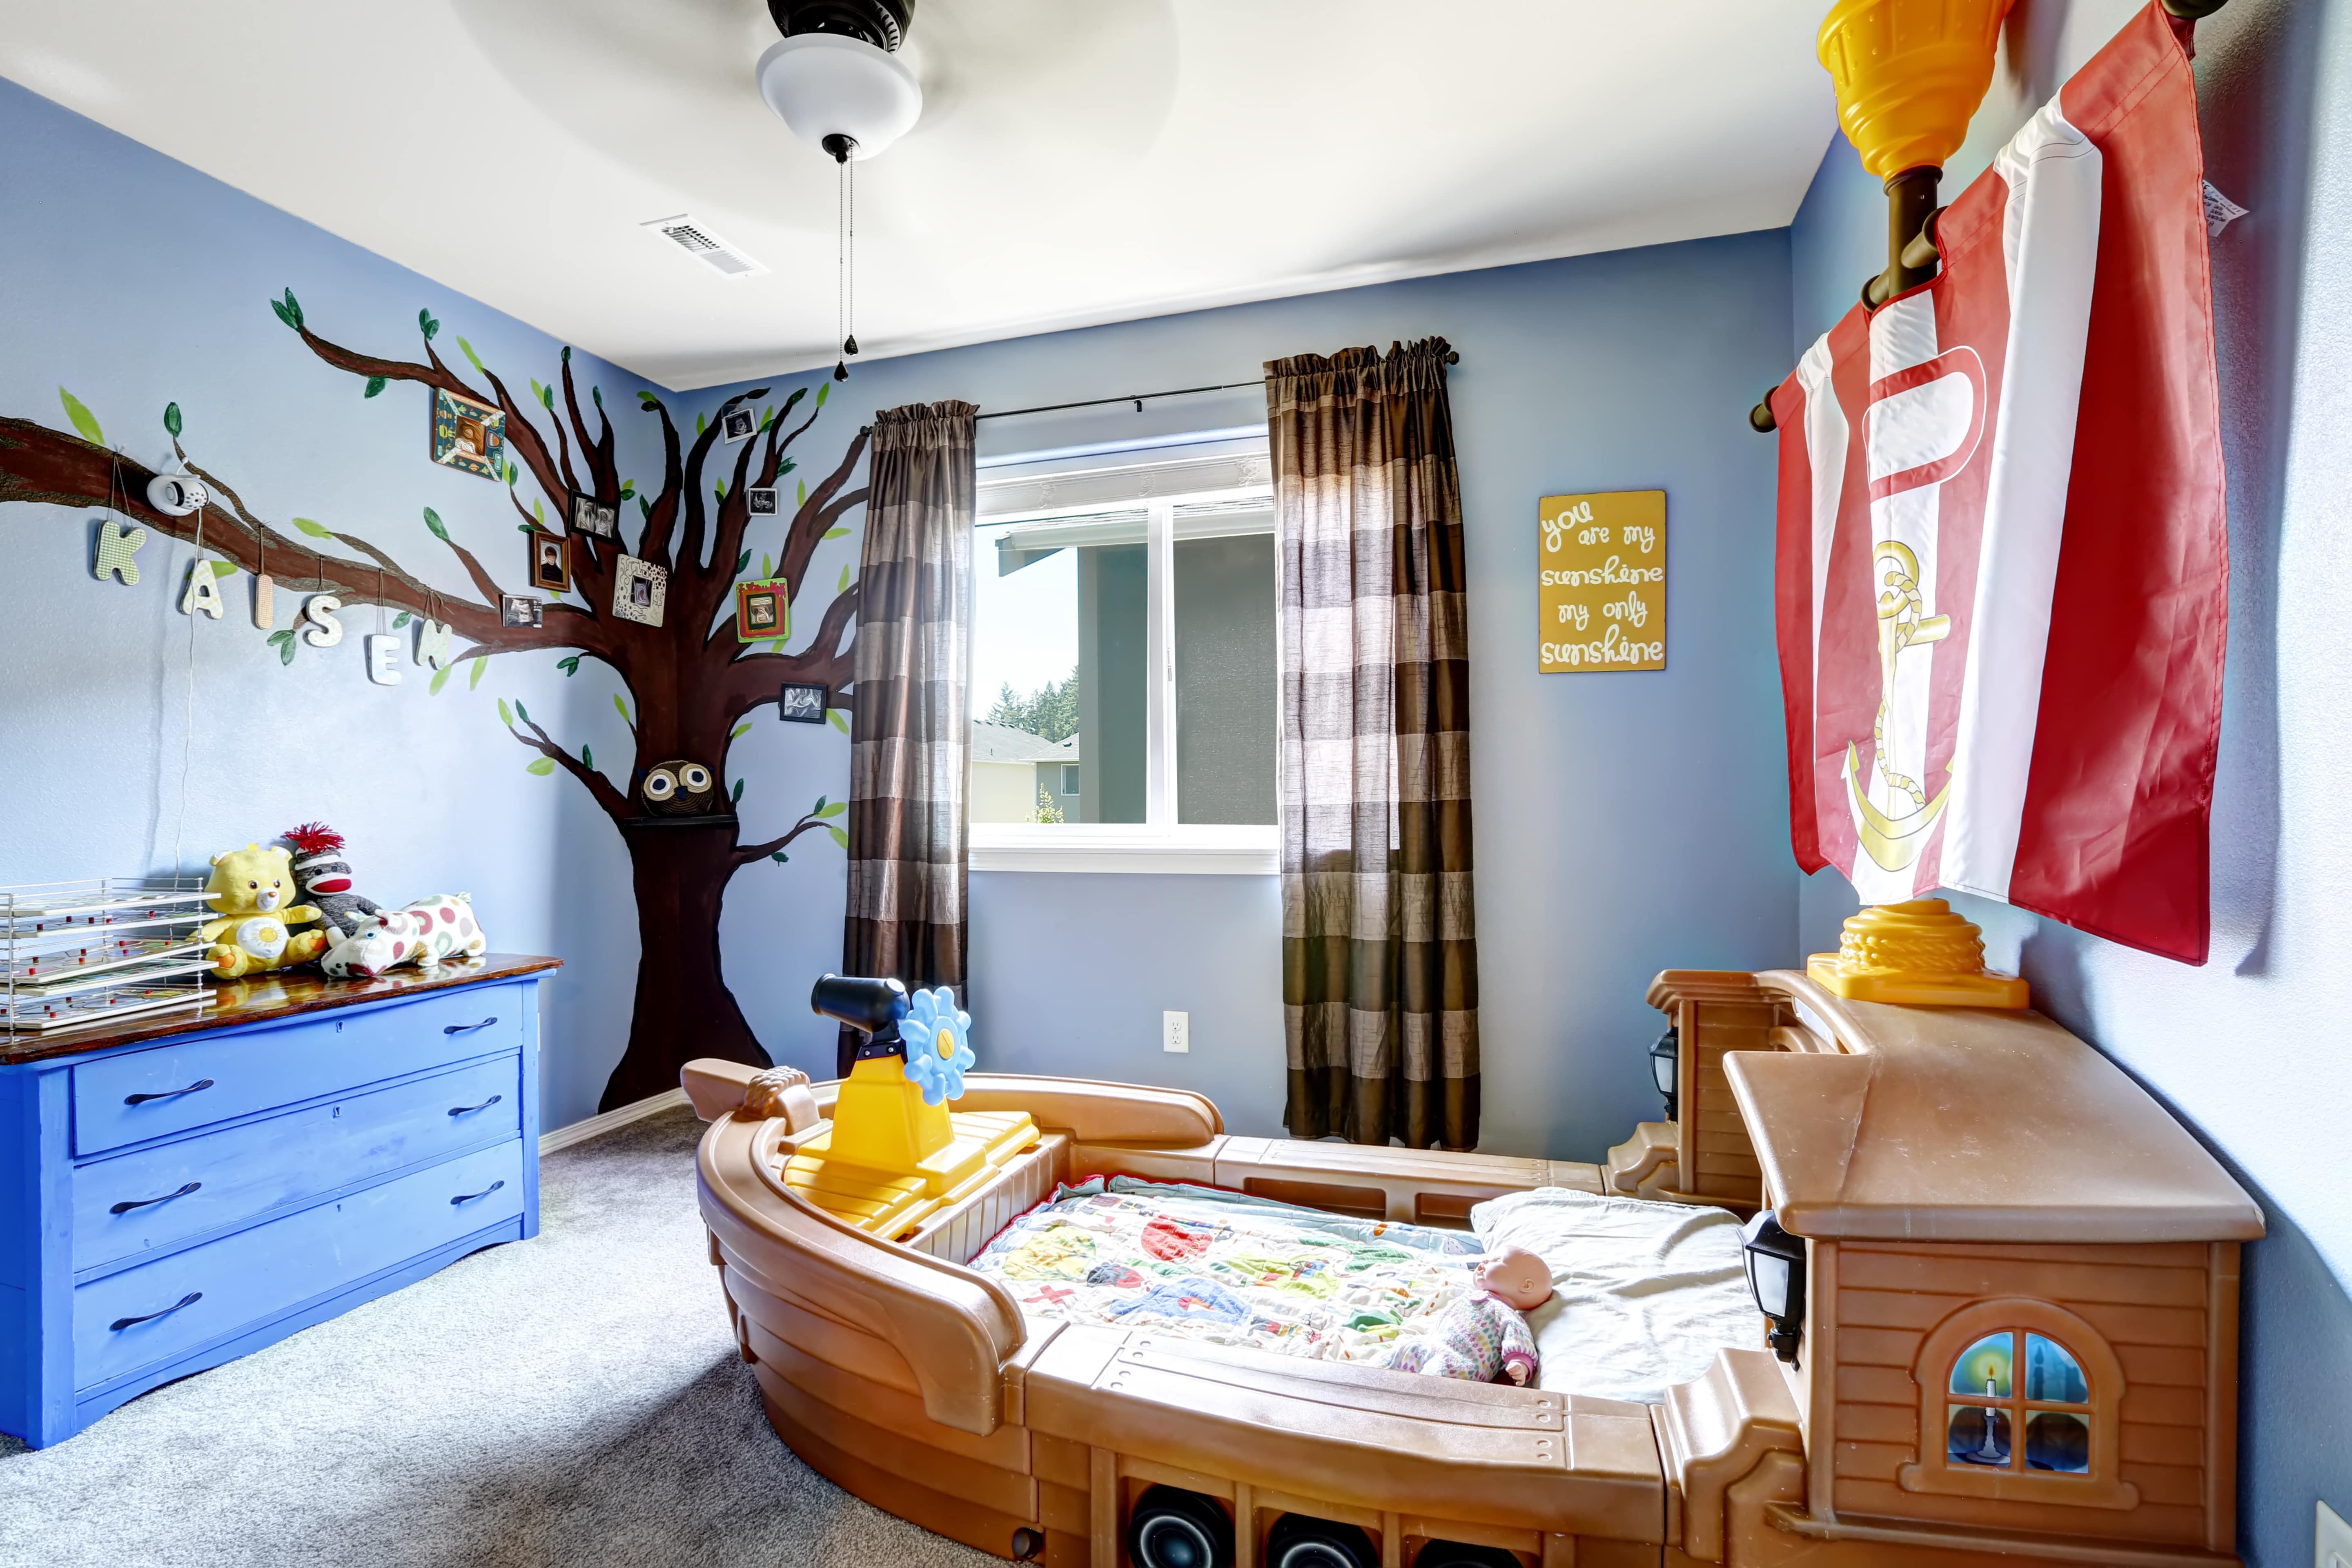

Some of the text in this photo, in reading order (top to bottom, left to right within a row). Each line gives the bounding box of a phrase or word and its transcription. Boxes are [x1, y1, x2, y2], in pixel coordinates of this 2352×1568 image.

[1541, 501, 1655, 553] you are my
[1541, 555, 1664, 586] sunshine
[1558, 590, 1648, 631] my only
[1541, 624, 1664, 665] sunshine
